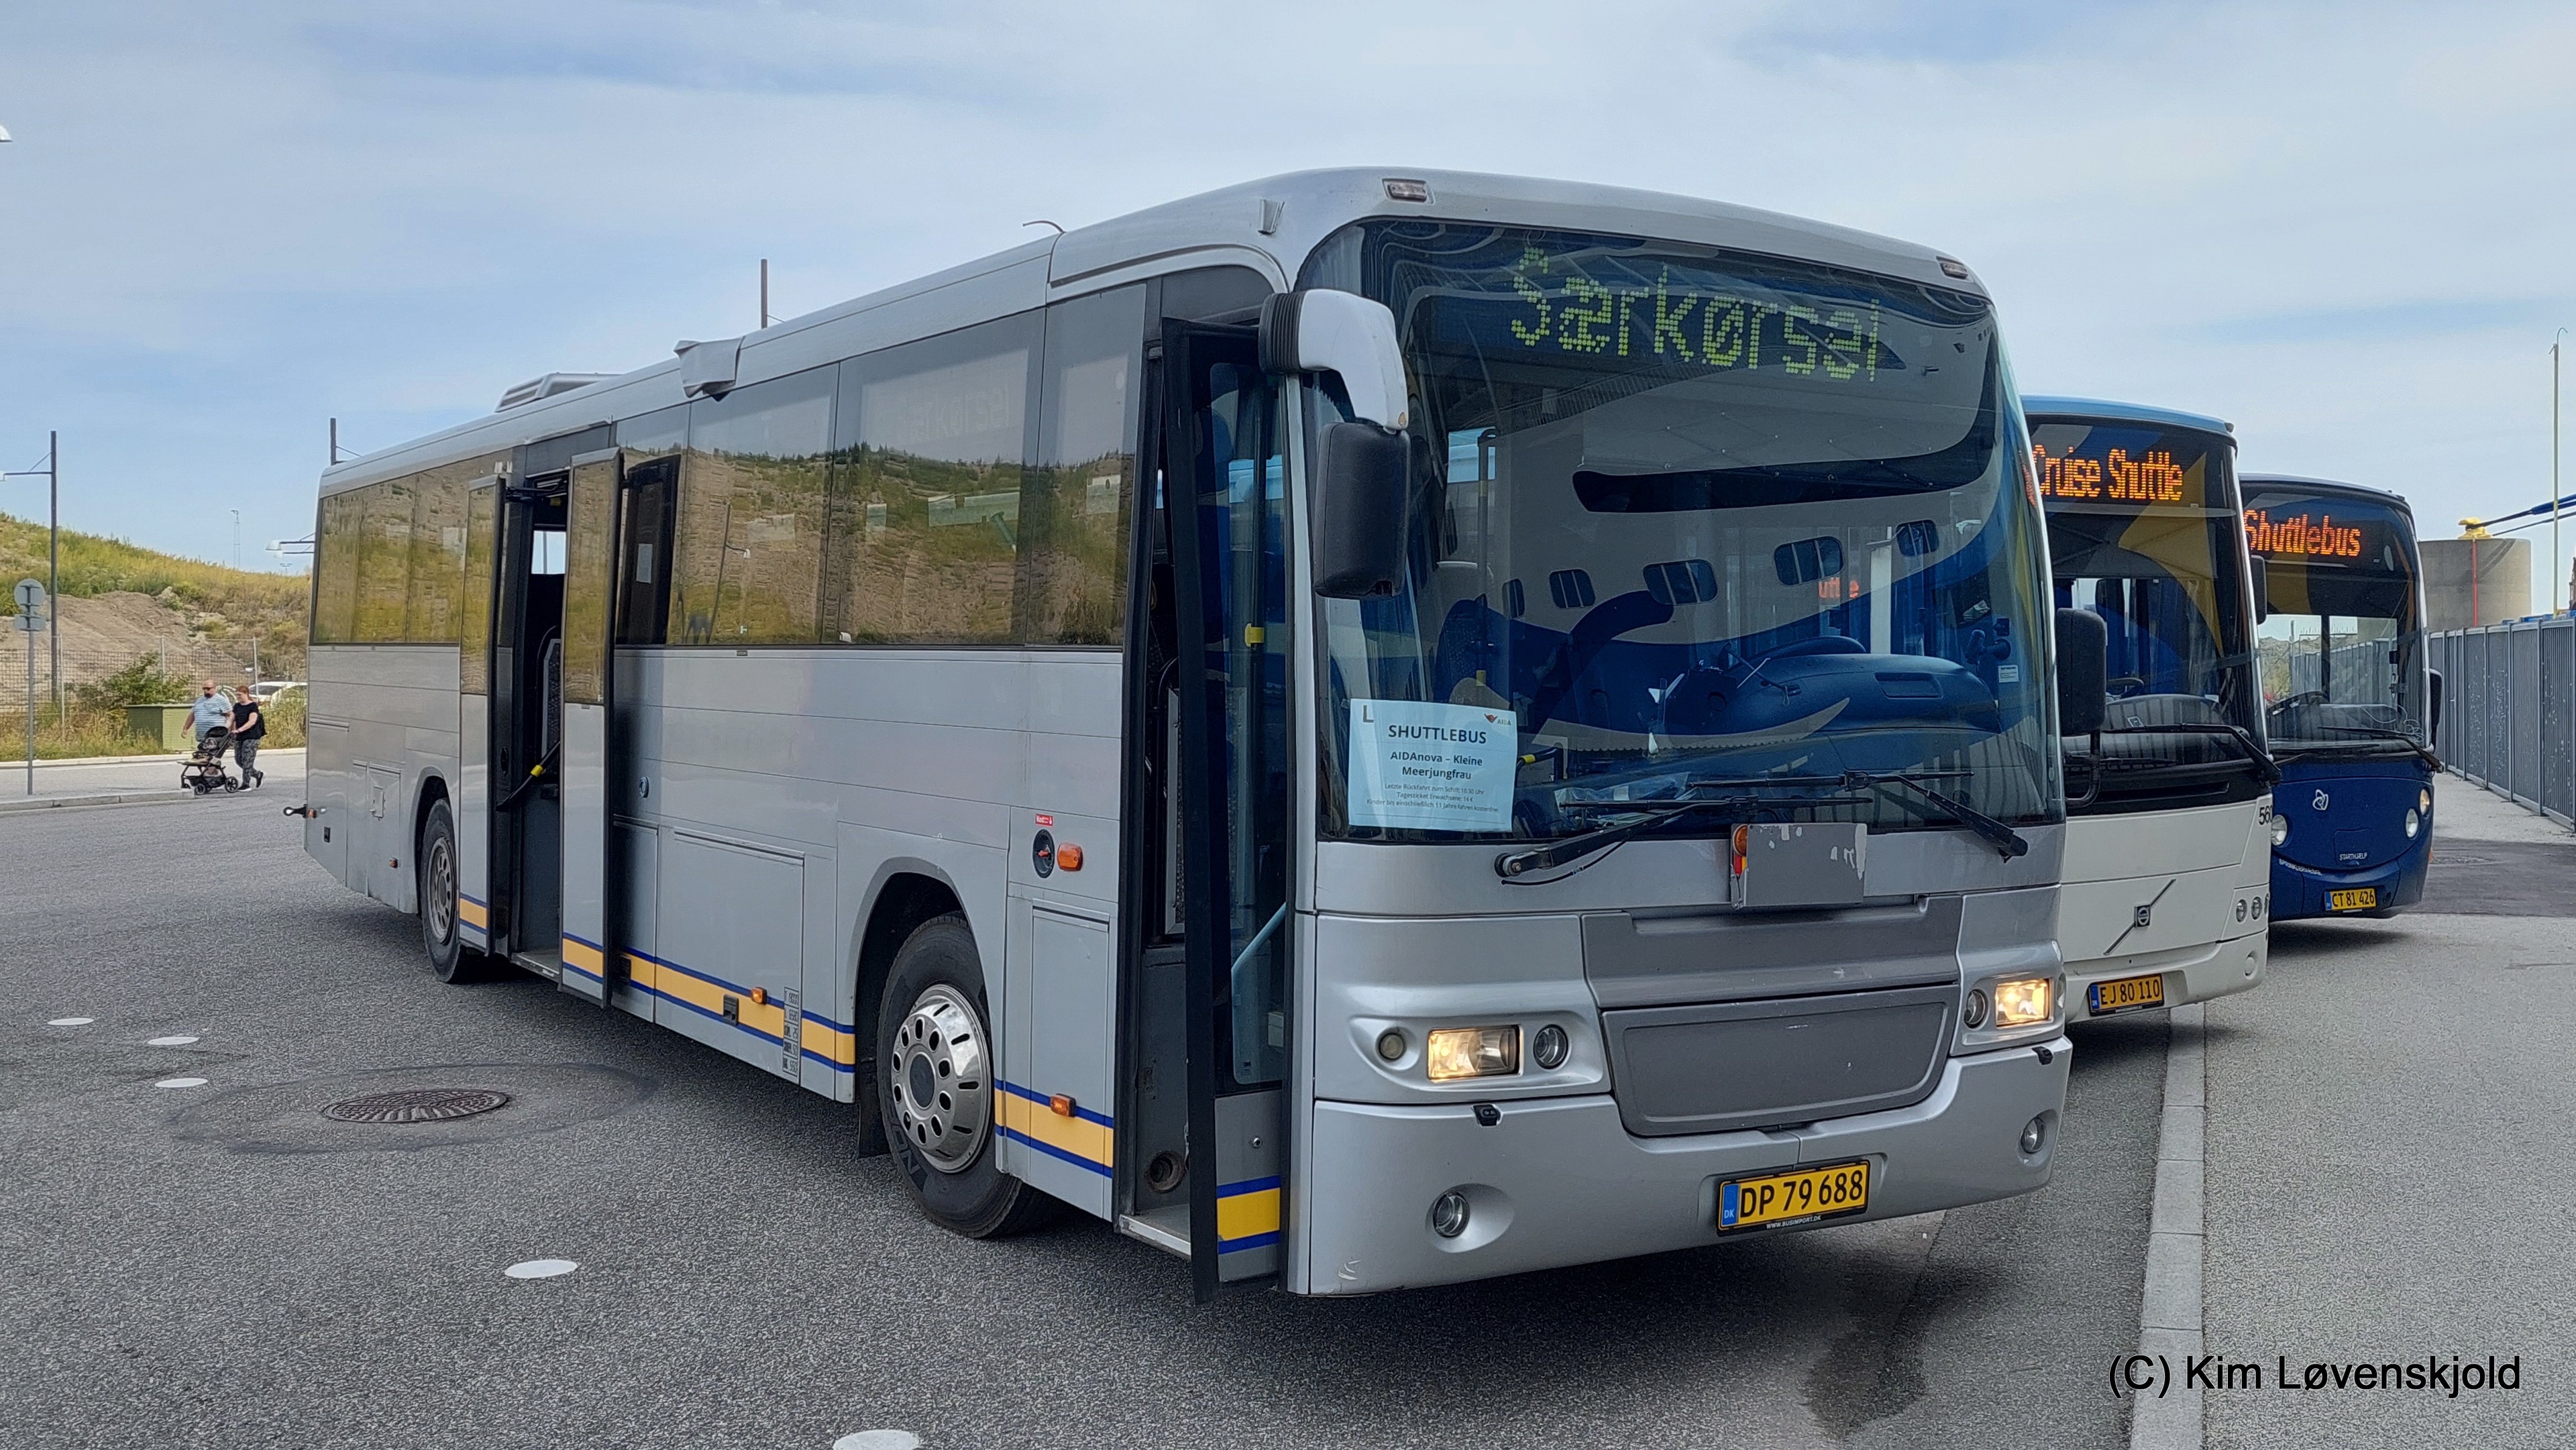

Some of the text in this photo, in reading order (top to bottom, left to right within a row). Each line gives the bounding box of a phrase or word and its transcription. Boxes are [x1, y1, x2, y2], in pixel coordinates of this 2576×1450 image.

[2032, 444, 2183, 501] Cruise Shuttle
[2243, 510, 2361, 556] Shuttlebus
[1388, 725, 1487, 744] SHUTTLEBUS
[1390, 752, 1443, 763] AIDAnova
[1453, 755, 1483, 766] Kleine
[1402, 767, 1472, 780] Meerjungfrau
[2332, 889, 2375, 907] CT 81 426
[2100, 979, 2160, 1005] EJ 80 110
[1740, 1170, 1863, 1218] DP 79 688
[1724, 1209, 1735, 1219] DK
